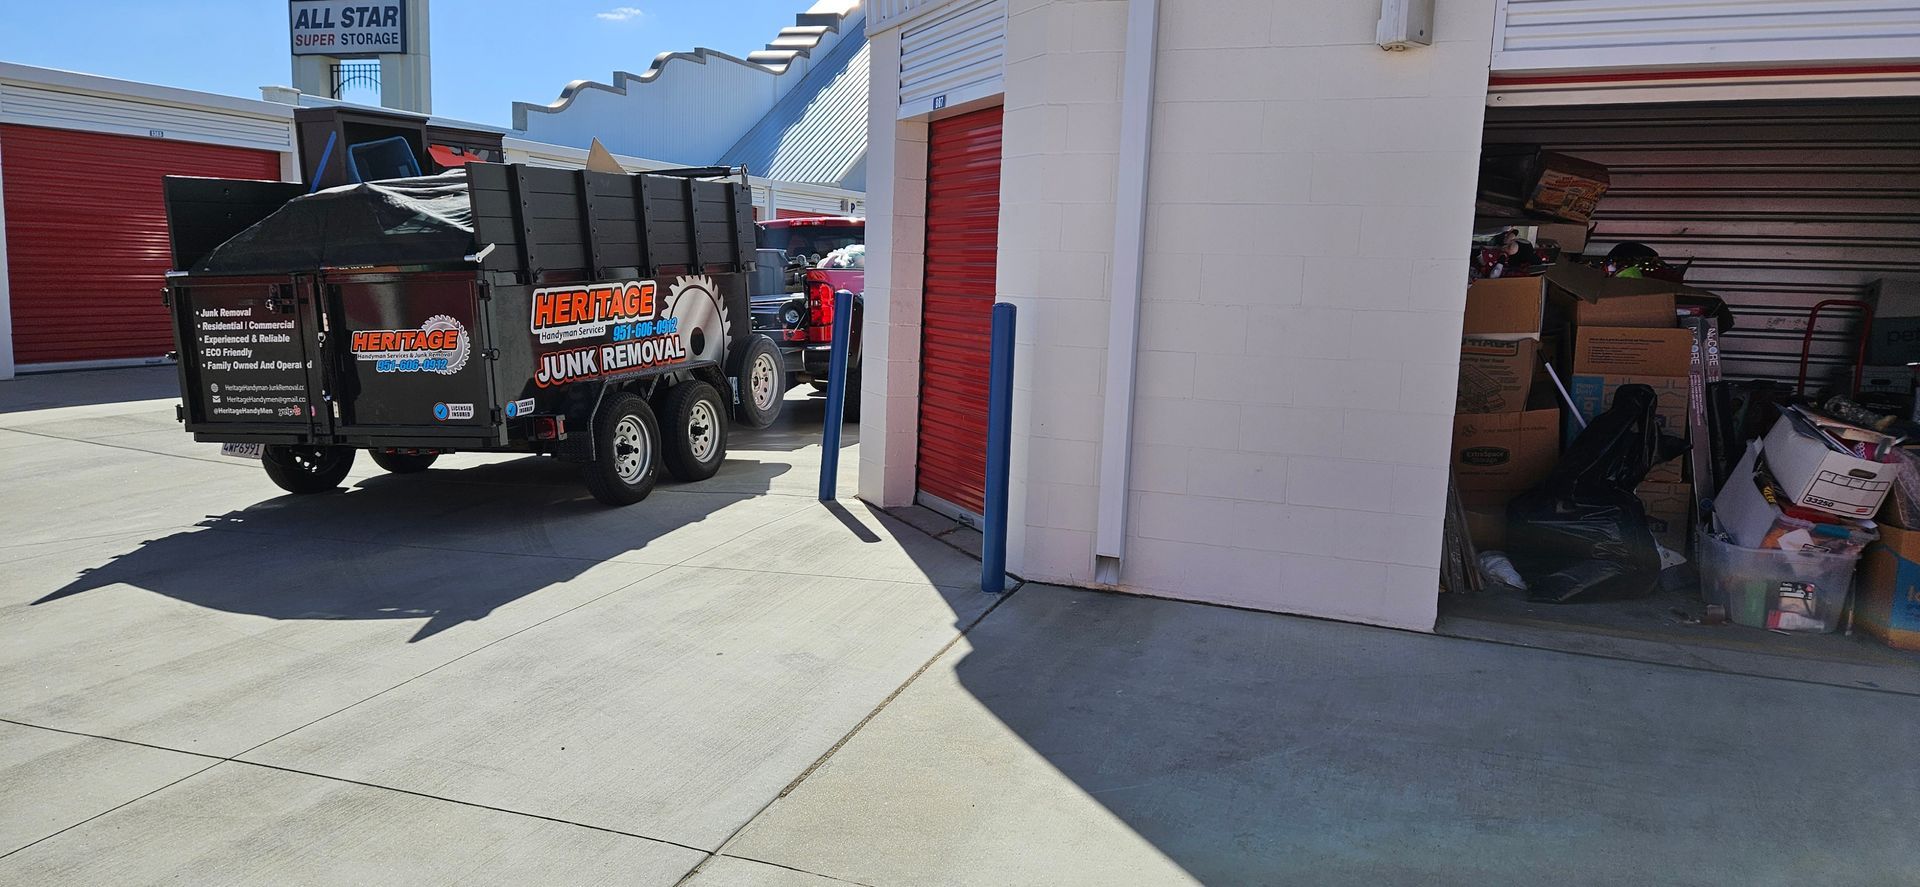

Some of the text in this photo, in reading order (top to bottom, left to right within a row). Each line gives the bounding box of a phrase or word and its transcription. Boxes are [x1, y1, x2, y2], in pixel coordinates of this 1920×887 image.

[294, 6, 399, 29] ALL STAR
[295, 32, 399, 46] SUPER STORAGE
[850, 202, 856, 214] P
[200, 307, 252, 318] Junk Removal
[534, 284, 655, 329] HERITAGE
[202, 321, 243, 331] Residential
[249, 320, 295, 329] Commercial
[613, 317, 678, 342] 951-606-0912
[204, 333, 291, 345] Experienced & Reliable
[541, 325, 605, 341] Handyman Services
[352, 330, 459, 352] HERITAGE
[205, 347, 253, 358] ECO Friendly
[207, 360, 232, 371] Family
[232, 360, 259, 369] Owned
[260, 360, 275, 369] And
[377, 359, 448, 372] 951-606-0912
[537, 336, 685, 383] JUNK REMOVAL
[213, 406, 273, 416] @HeritageHandyMen
[1805, 496, 1835, 508] 33250
